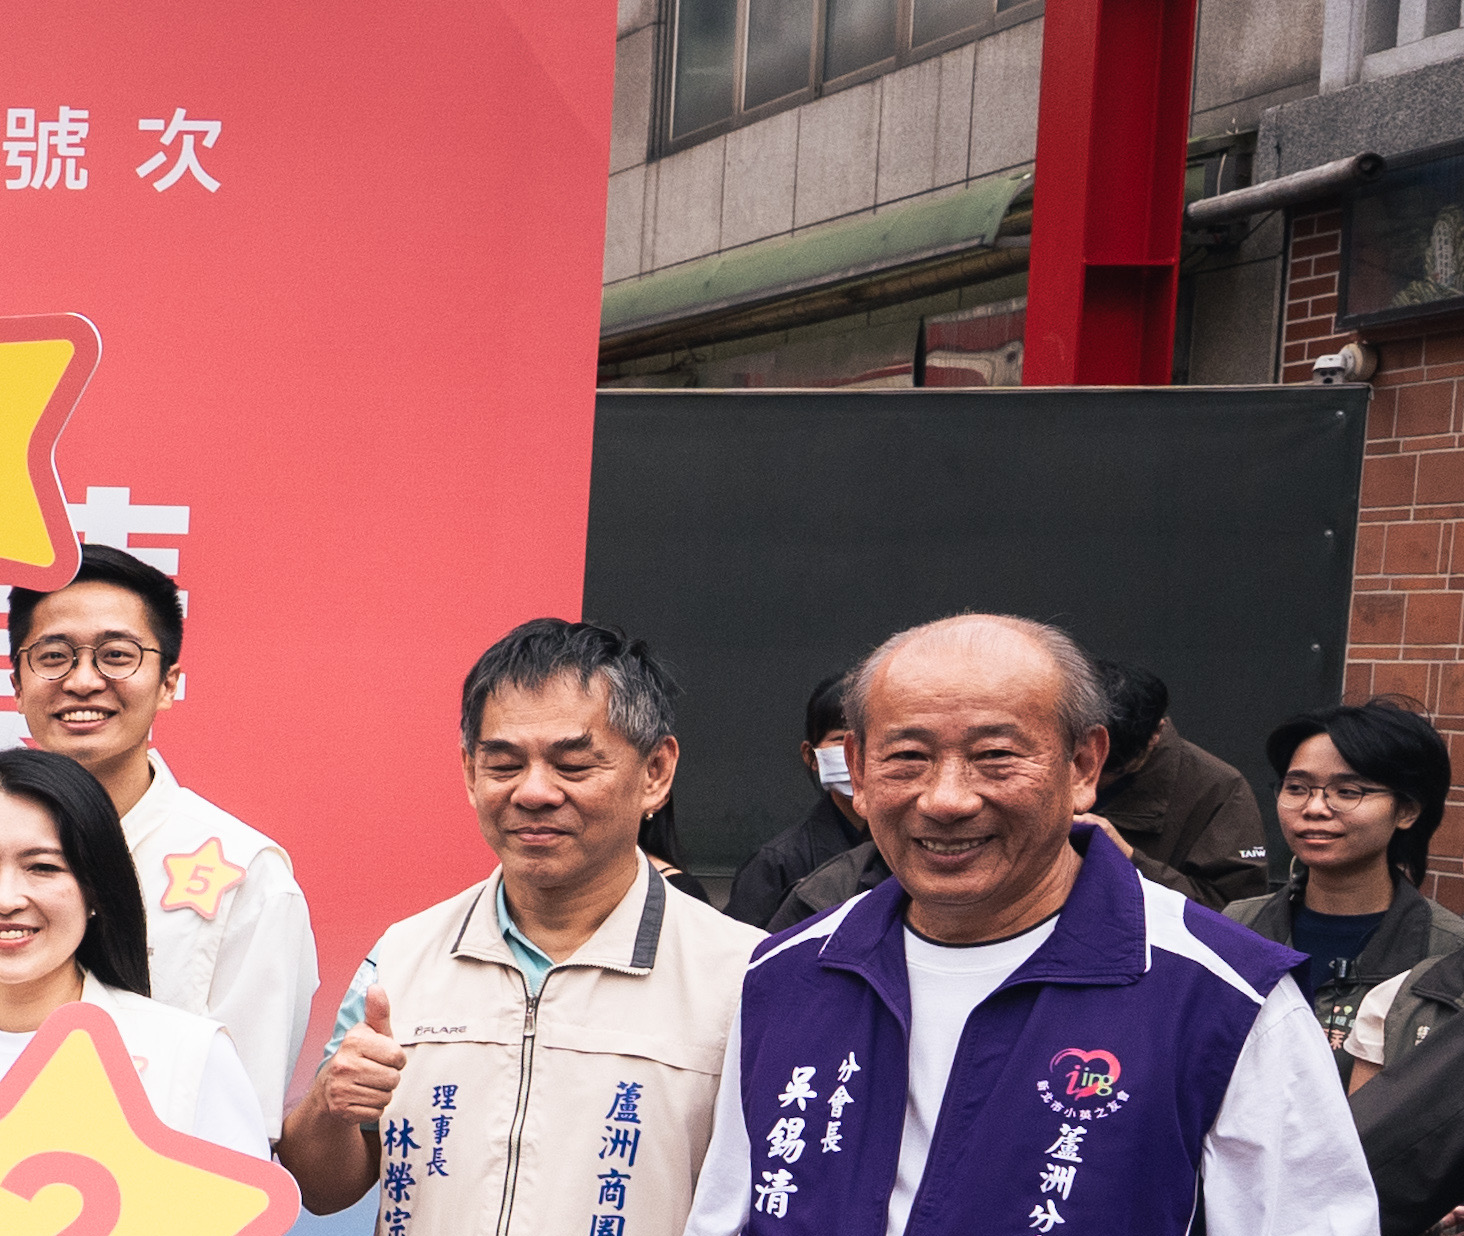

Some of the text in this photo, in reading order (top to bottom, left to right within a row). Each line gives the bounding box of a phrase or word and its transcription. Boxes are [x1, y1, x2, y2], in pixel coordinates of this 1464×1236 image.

[184, 865, 210, 895] 5
[426, 1083, 459, 1178] 理事長
[754, 1065, 818, 1219] 吳錫清
[820, 1050, 862, 1154] 分會長
